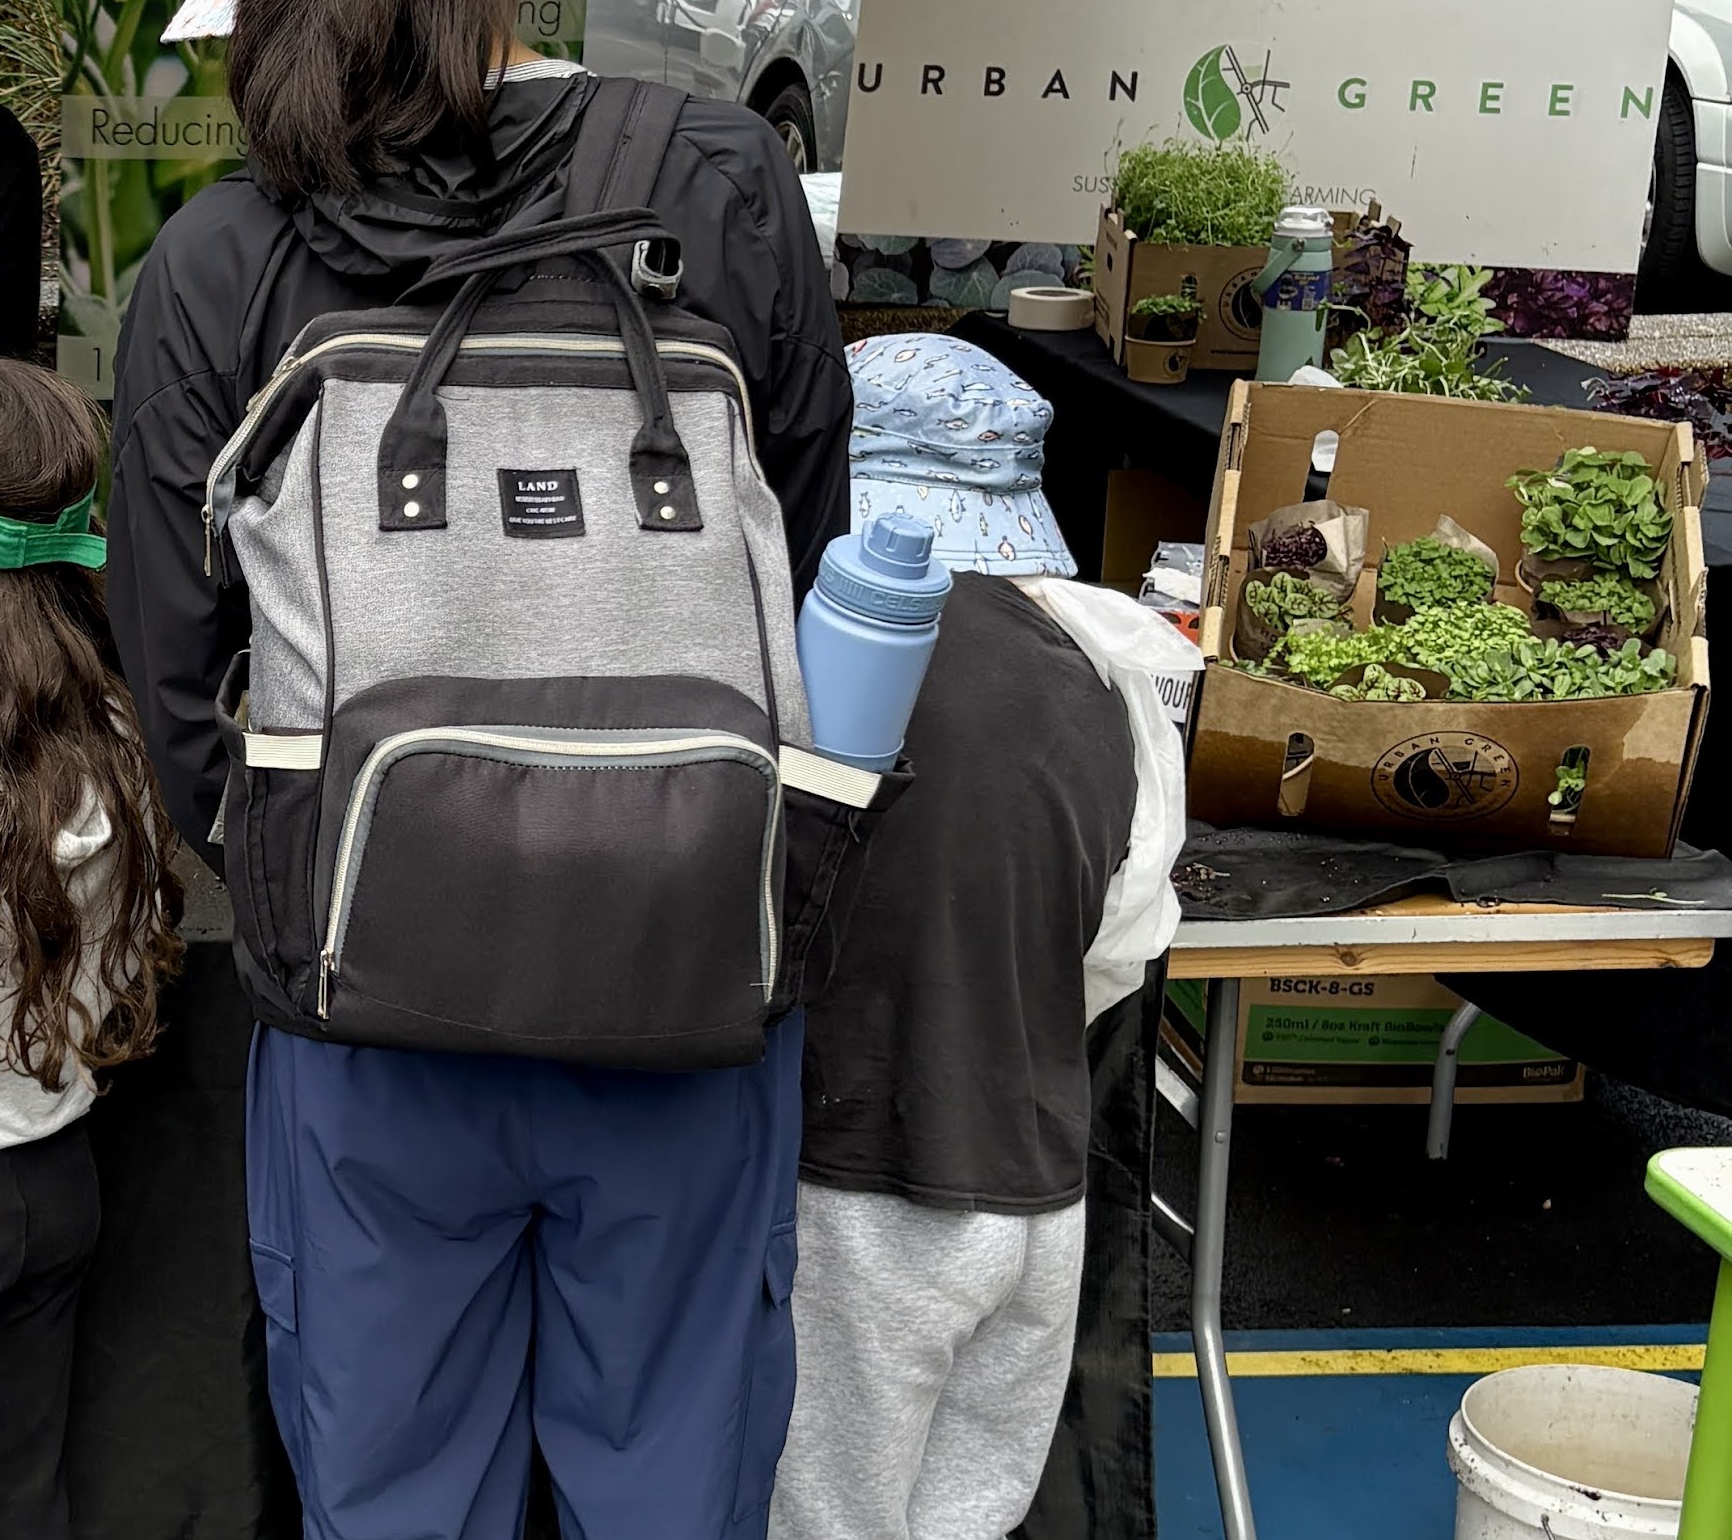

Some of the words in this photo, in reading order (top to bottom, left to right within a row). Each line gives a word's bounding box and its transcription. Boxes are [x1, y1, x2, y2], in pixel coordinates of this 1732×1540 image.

[857, 62, 1138, 102] URBAN
[1338, 77, 1654, 120] GREEN
[1290, 186, 1377, 206] ARMING
[517, 481, 559, 492] LAND
[1378, 737, 1440, 782] URBAN
[1270, 978, 1375, 996] BSCK-8-GS
